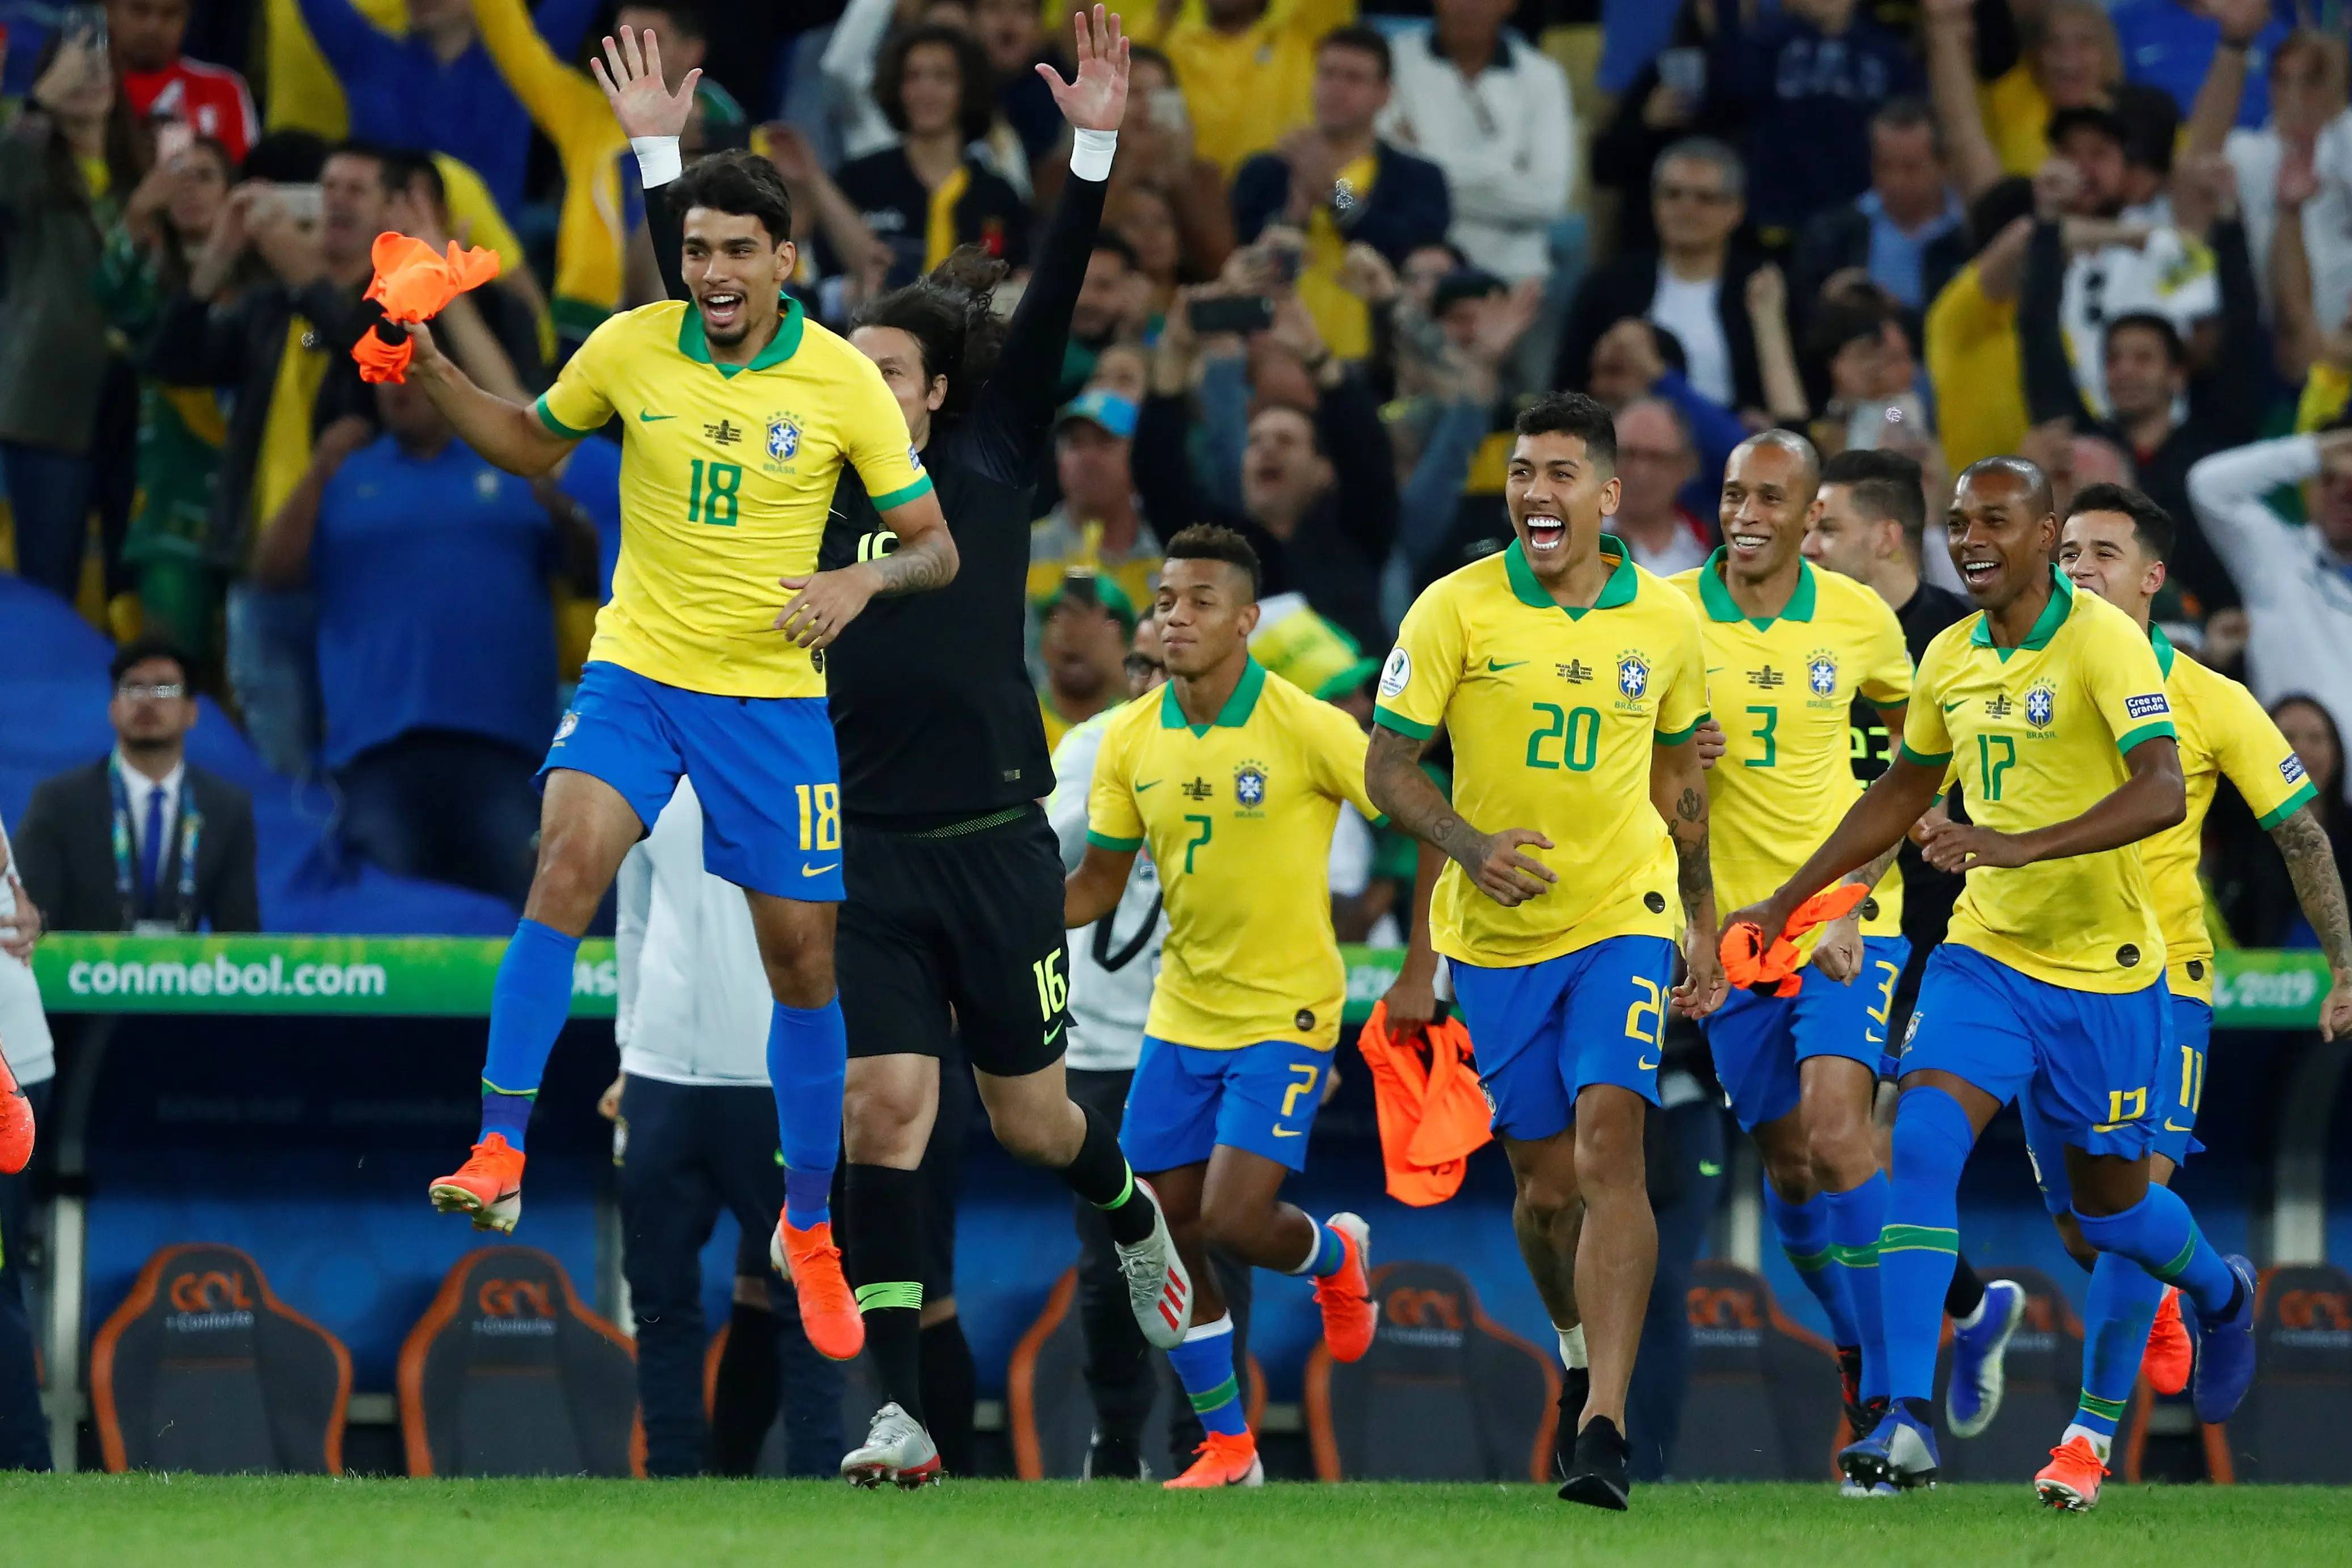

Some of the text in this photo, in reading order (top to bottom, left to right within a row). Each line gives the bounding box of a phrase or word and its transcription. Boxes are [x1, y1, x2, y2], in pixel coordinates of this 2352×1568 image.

[688, 459, 742, 527] 18
[763, 463, 796, 475] BRASIL
[1614, 701, 1644, 712] BRASIL
[1807, 699, 1834, 709] BRASIL
[2128, 697, 2151, 707] Cree
[2131, 703, 2164, 717] grande
[1526, 702, 1601, 772] 20
[1744, 706, 1778, 766] 3
[1977, 734, 2016, 801] 17
[795, 782, 842, 851] 18
[1184, 814, 1212, 874] 7
[68, 955, 386, 996] conmebol.com
[1033, 947, 1067, 1022] 16
[1866, 960, 1899, 1026] 3
[2235, 969, 2317, 1009] 2019
[1280, 1063, 1318, 1117] 7
[2179, 1044, 2203, 1115] 11
[171, 1270, 253, 1313] GOL
[479, 1278, 558, 1318] GOL
